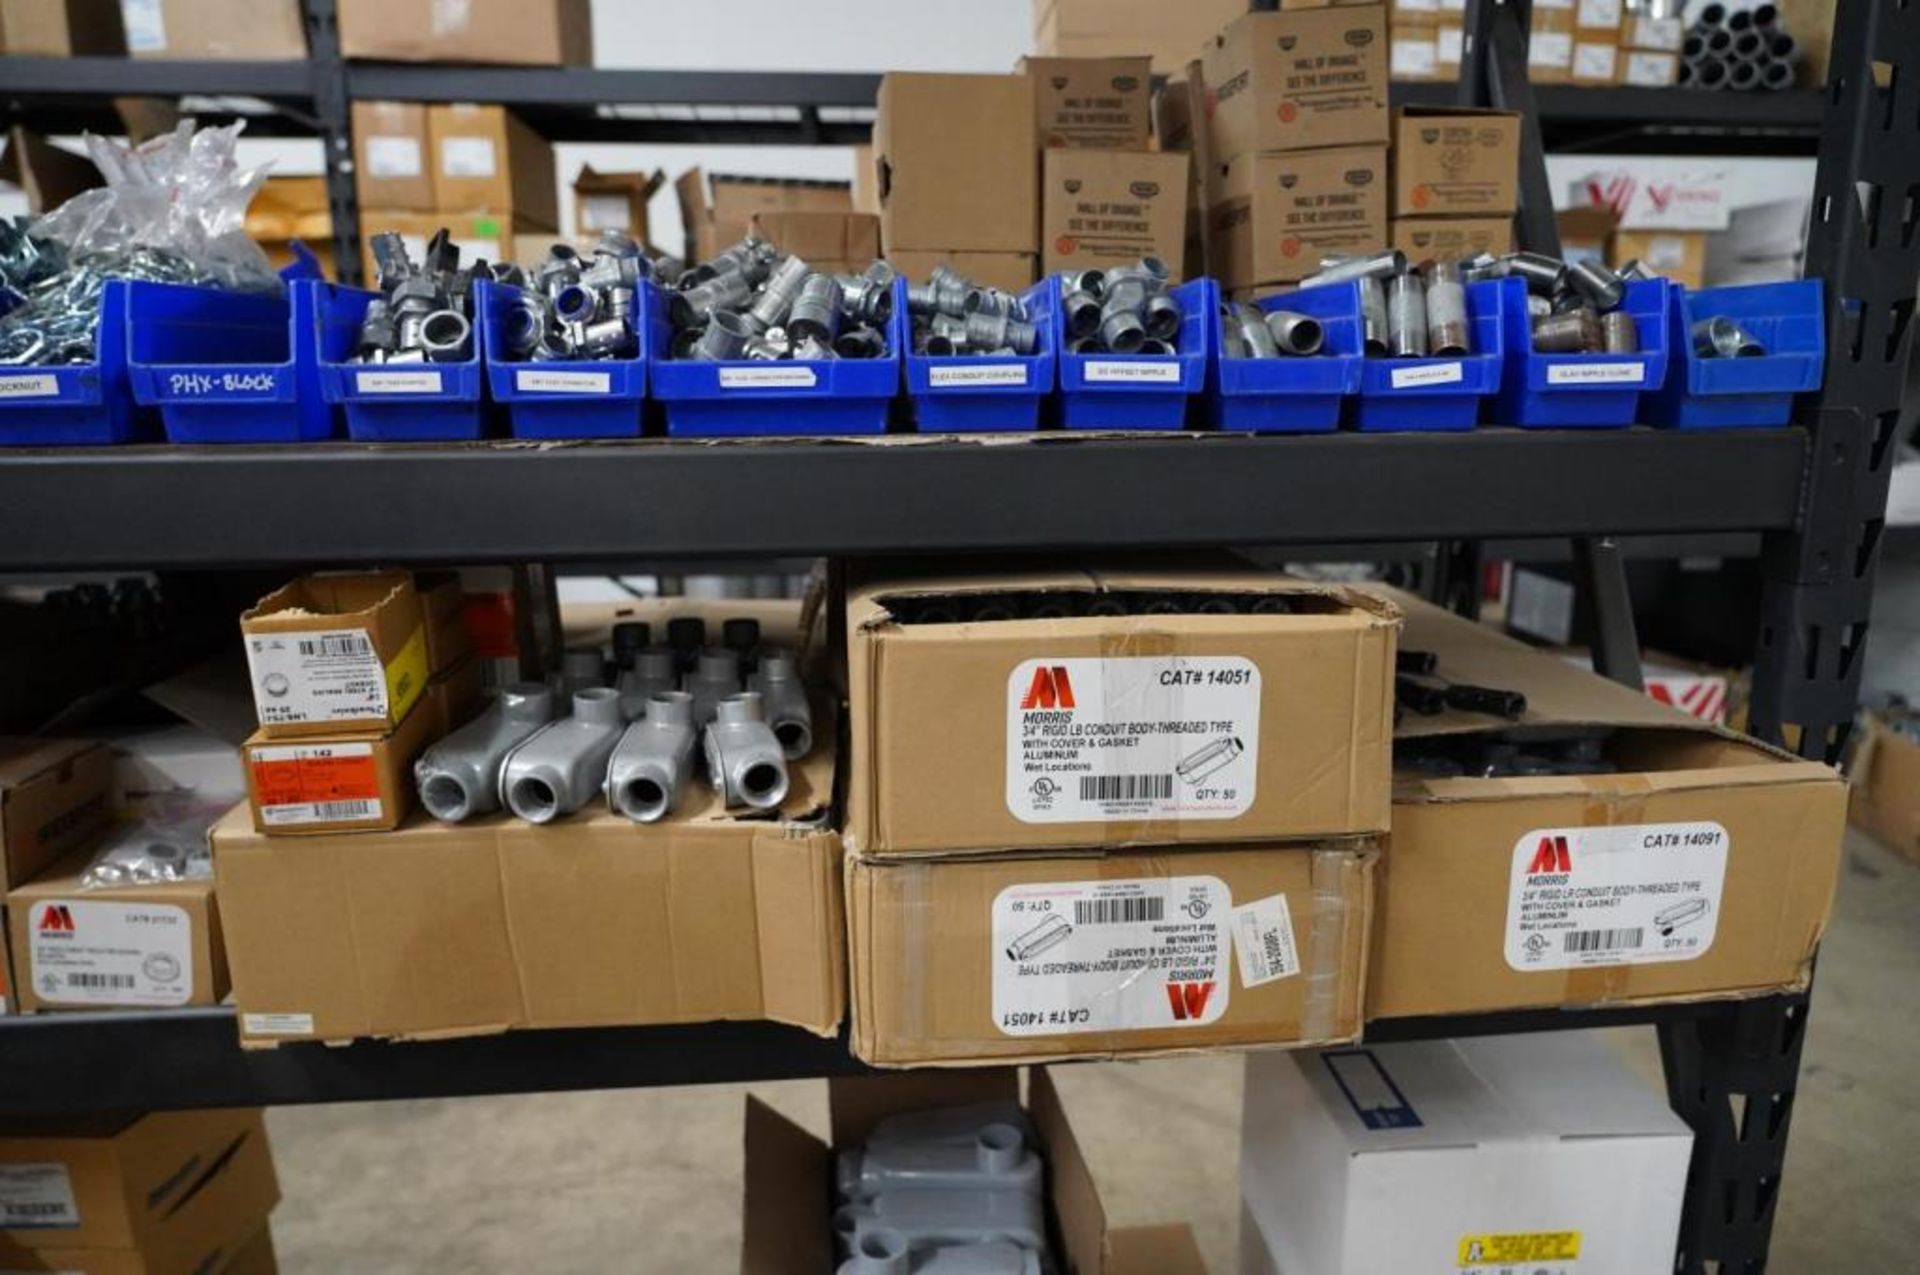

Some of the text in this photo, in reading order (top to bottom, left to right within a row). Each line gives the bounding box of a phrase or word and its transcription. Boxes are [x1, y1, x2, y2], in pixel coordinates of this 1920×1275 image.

[170, 374, 274, 394] PHX-BLOCK
[1160, 669, 1252, 686] CAT# 14051
[1022, 712, 1073, 724] MORRIS
[1042, 724, 1068, 736] RIGID
[1070, 724, 1082, 736] LB
[1084, 723, 1128, 735] CONDUIT
[1128, 722, 1208, 734] BODY-THREADED
[1210, 720, 1233, 733] TYPE
[1022, 737, 1139, 749] WITH COVER & GASKET
[1023, 750, 1078, 760] ALUMINUM
[1024, 762, 1092, 772] Wet Locations
[1644, 832, 1721, 849] CAT# 14091
[1526, 874, 1569, 886] MORRIS
[1575, 886, 1611, 898] CONDUIT
[1612, 883, 1680, 896] BODY-THREADED
[1681, 881, 1702, 893] TYPE
[1522, 902, 1544, 912] WITH
[1545, 901, 1576, 910] COVER
[1586, 899, 1620, 908] GASKET
[1166, 934, 1216, 944] ALUMINUM
[1108, 948, 1146, 958] GASKET
[1158, 945, 1192, 954] COVER
[1194, 944, 1217, 953] WITH
[1018, 964, 1040, 976] TYPE
[1042, 960, 1118, 974] BODY-THREADED
[1004, 1008, 1090, 1026] CAT# 14051
